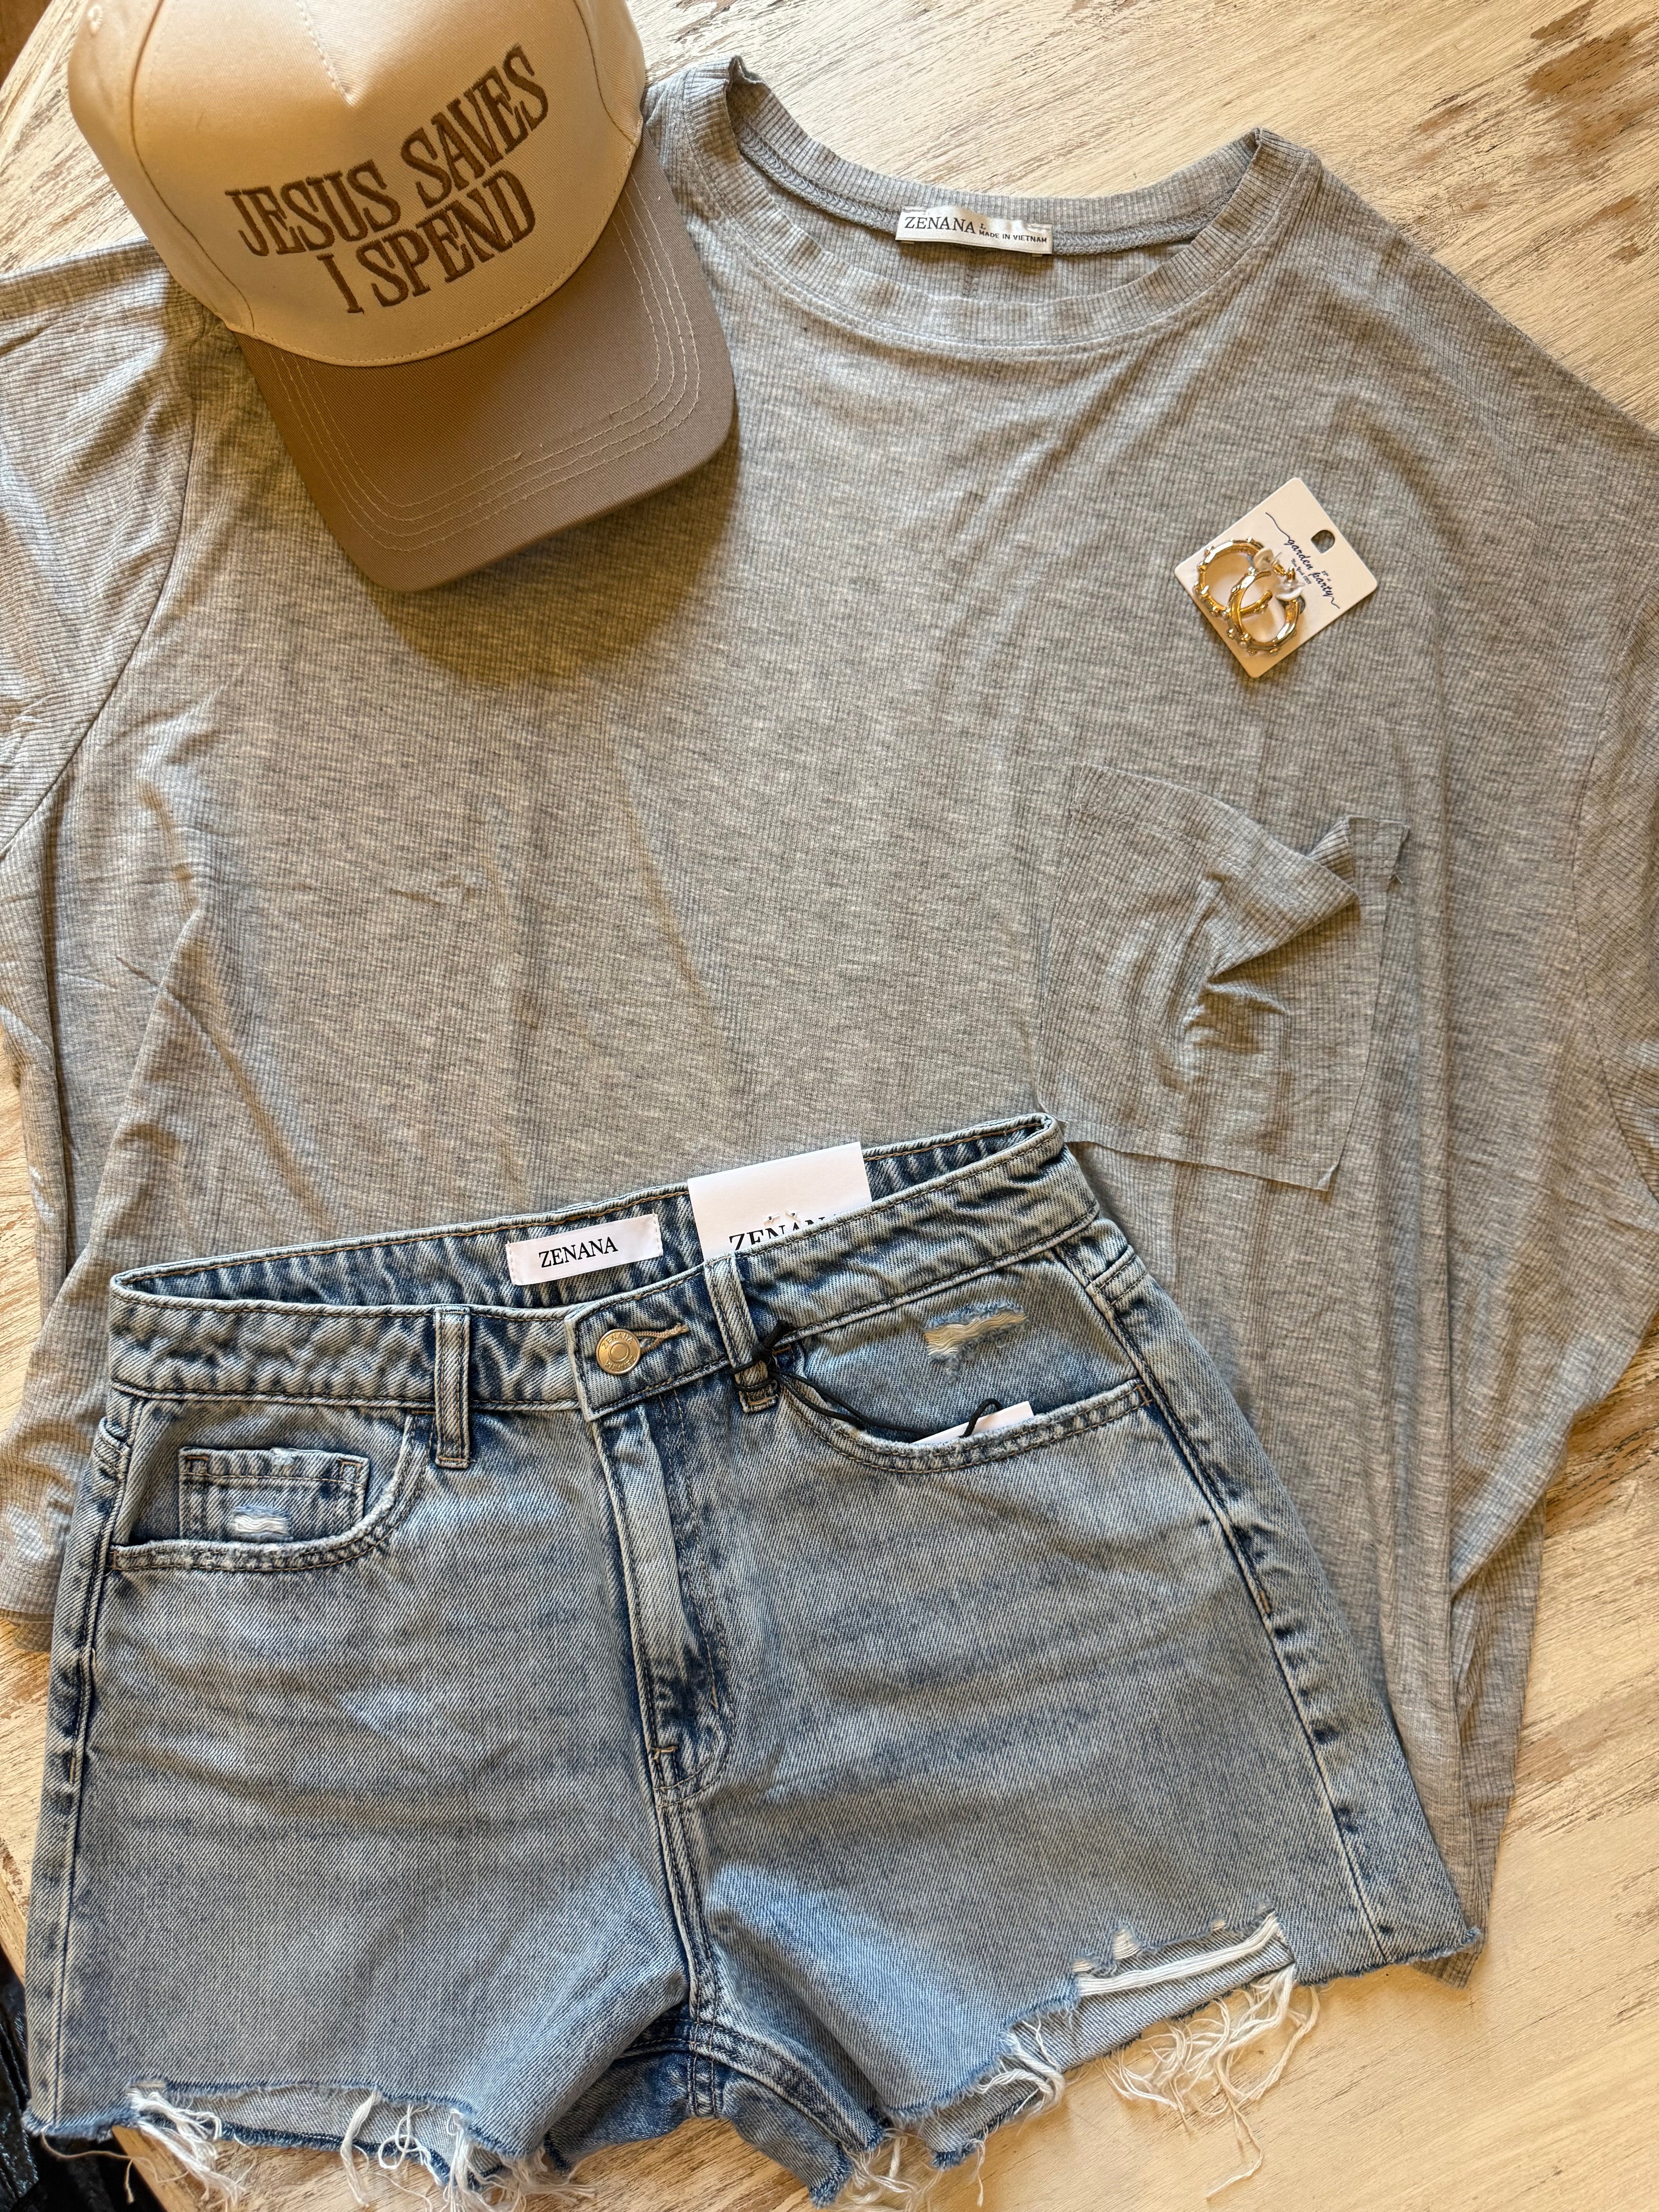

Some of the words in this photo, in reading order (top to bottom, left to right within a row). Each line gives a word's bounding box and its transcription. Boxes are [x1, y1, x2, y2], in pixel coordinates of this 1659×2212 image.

[225, 159, 401, 257] JESUS
[400, 43, 549, 209] SAVES
[904, 216, 977, 234] ZENANA
[979, 229, 1000, 239] MADE
[1013, 235, 1048, 244] VIETNAM
[316, 253, 365, 314] I
[356, 169, 536, 307] SPEND
[1308, 572, 1335, 597] party
[538, 1236, 618, 1268] ZENANA
[601, 1331, 633, 1349] ZENANA
